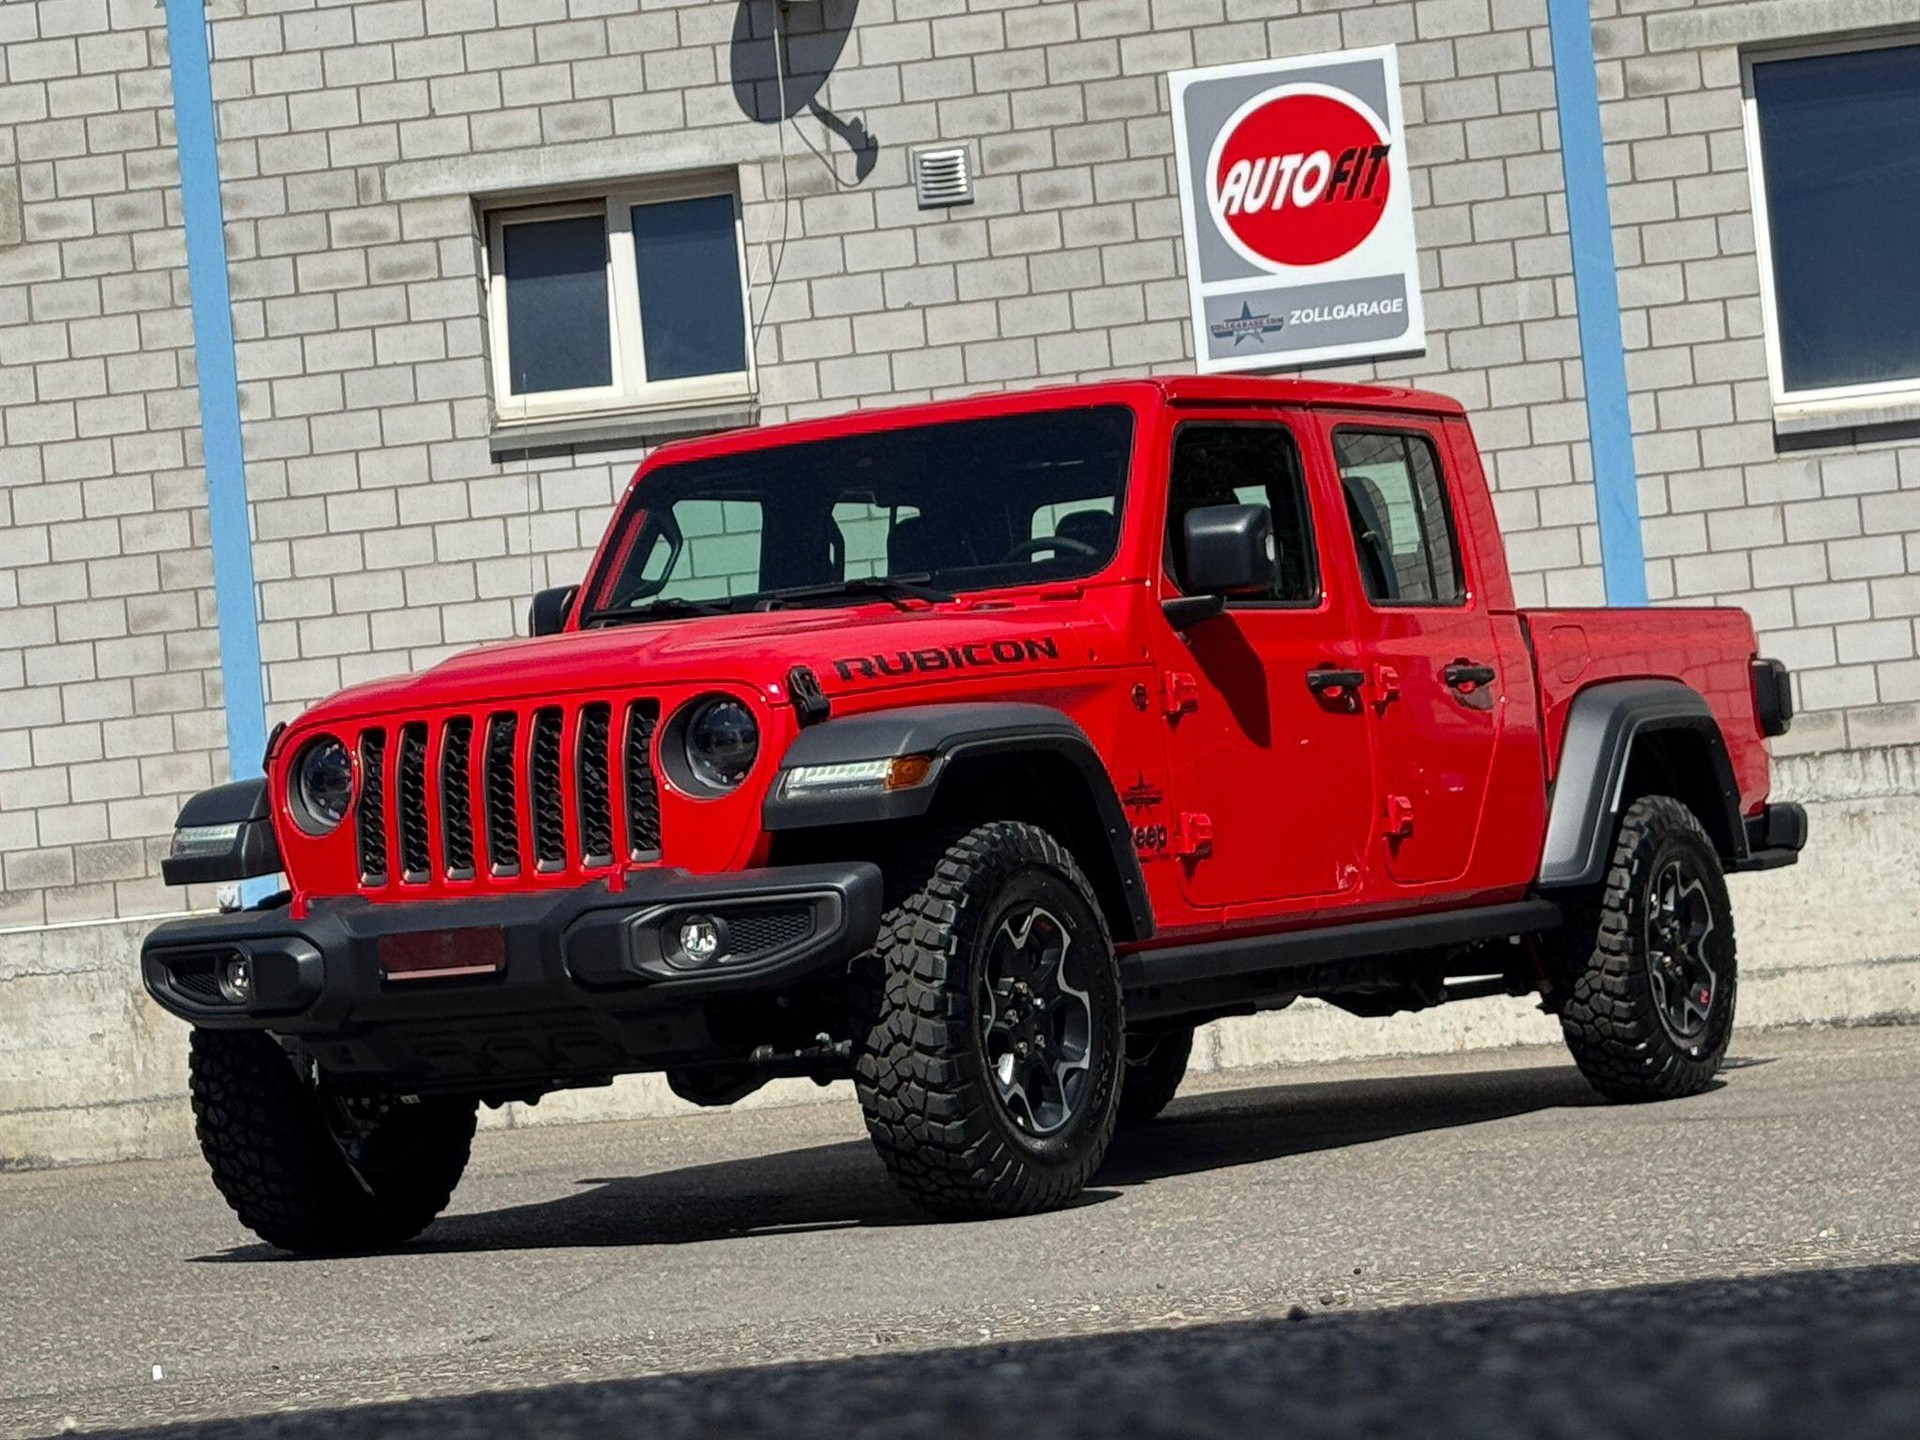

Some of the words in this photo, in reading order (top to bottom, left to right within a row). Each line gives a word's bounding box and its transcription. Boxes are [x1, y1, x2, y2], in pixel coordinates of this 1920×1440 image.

[1220, 144, 1391, 216] AUTOFIT
[1289, 298, 1404, 325] ZOLLGARAGE
[834, 637, 1059, 681] RUBICON
[1132, 824, 1168, 854] eep
